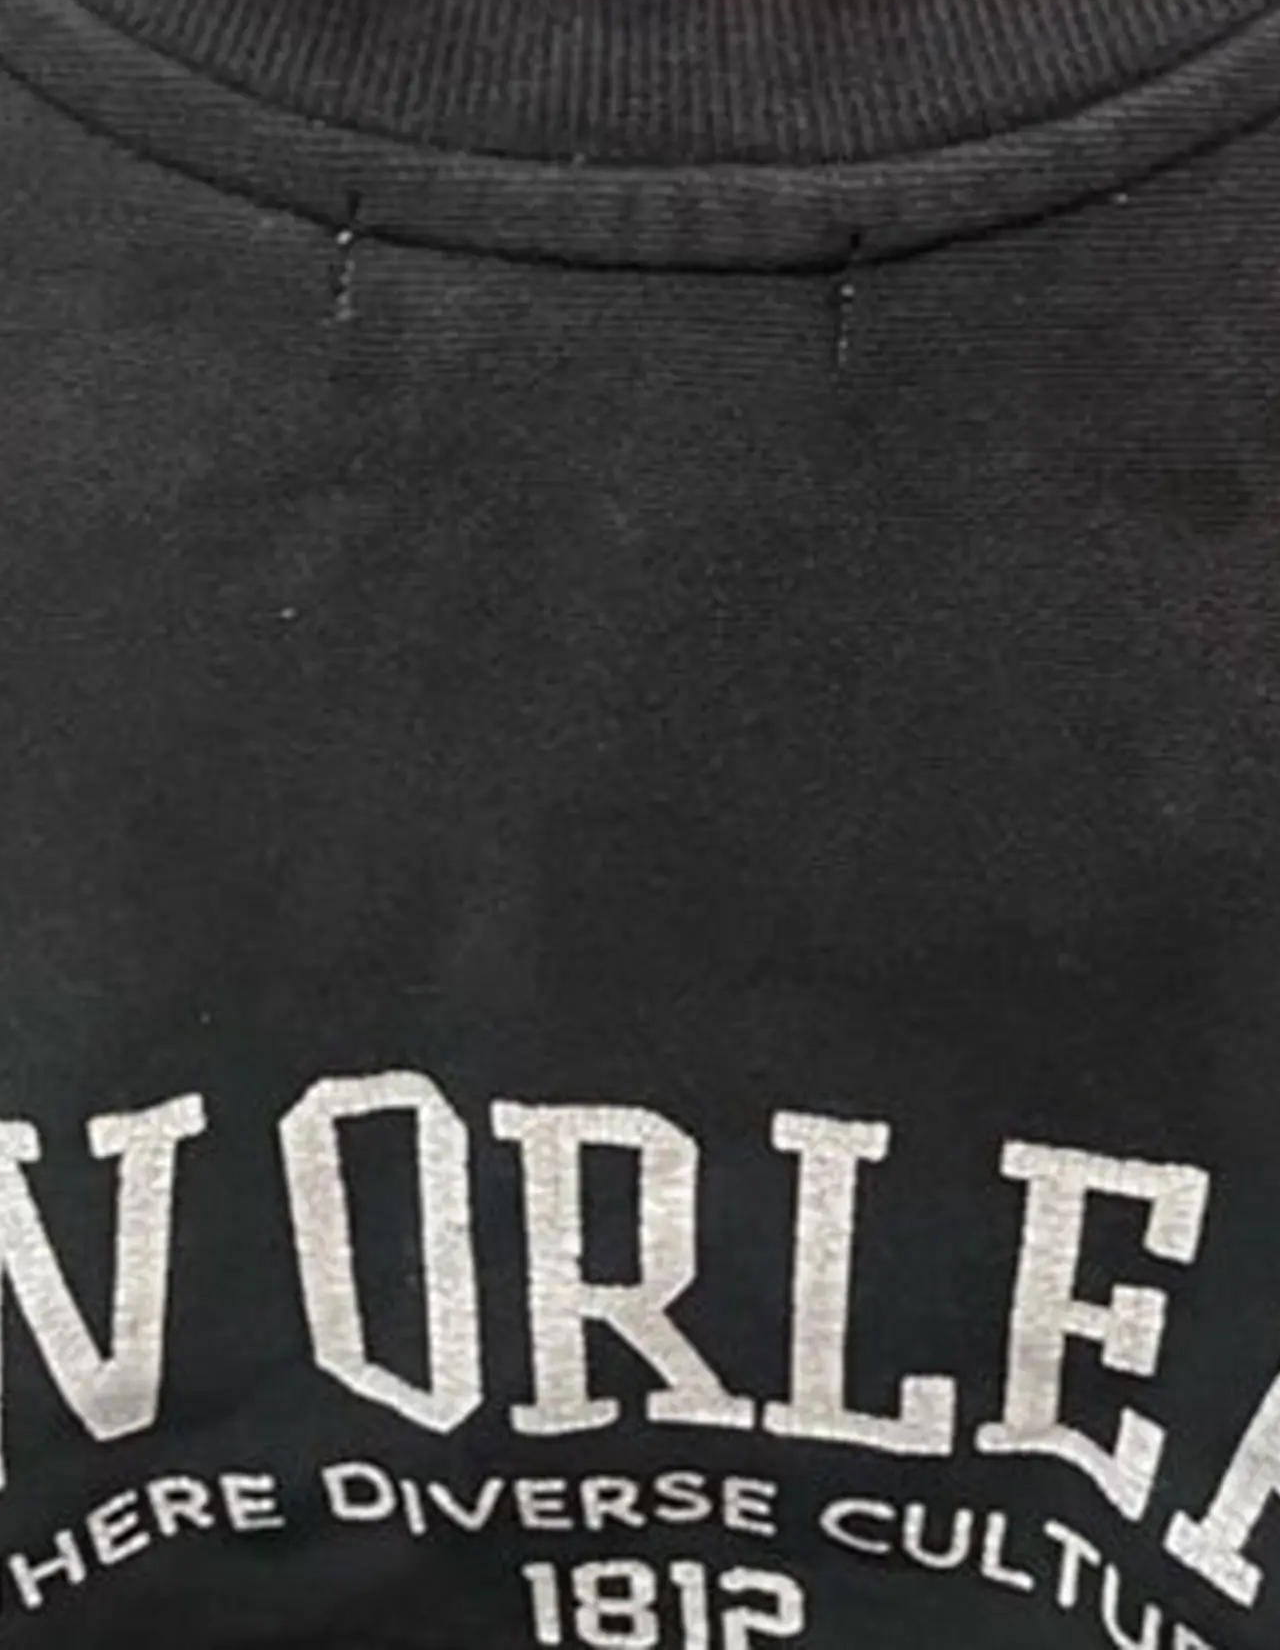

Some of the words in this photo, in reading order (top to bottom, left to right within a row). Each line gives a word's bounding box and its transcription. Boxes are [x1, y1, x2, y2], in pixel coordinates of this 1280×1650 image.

[321, 1461, 777, 1536] DIVERSE
[819, 1498, 1213, 1650] CULTU
[521, 1559, 805, 1650] 1812
